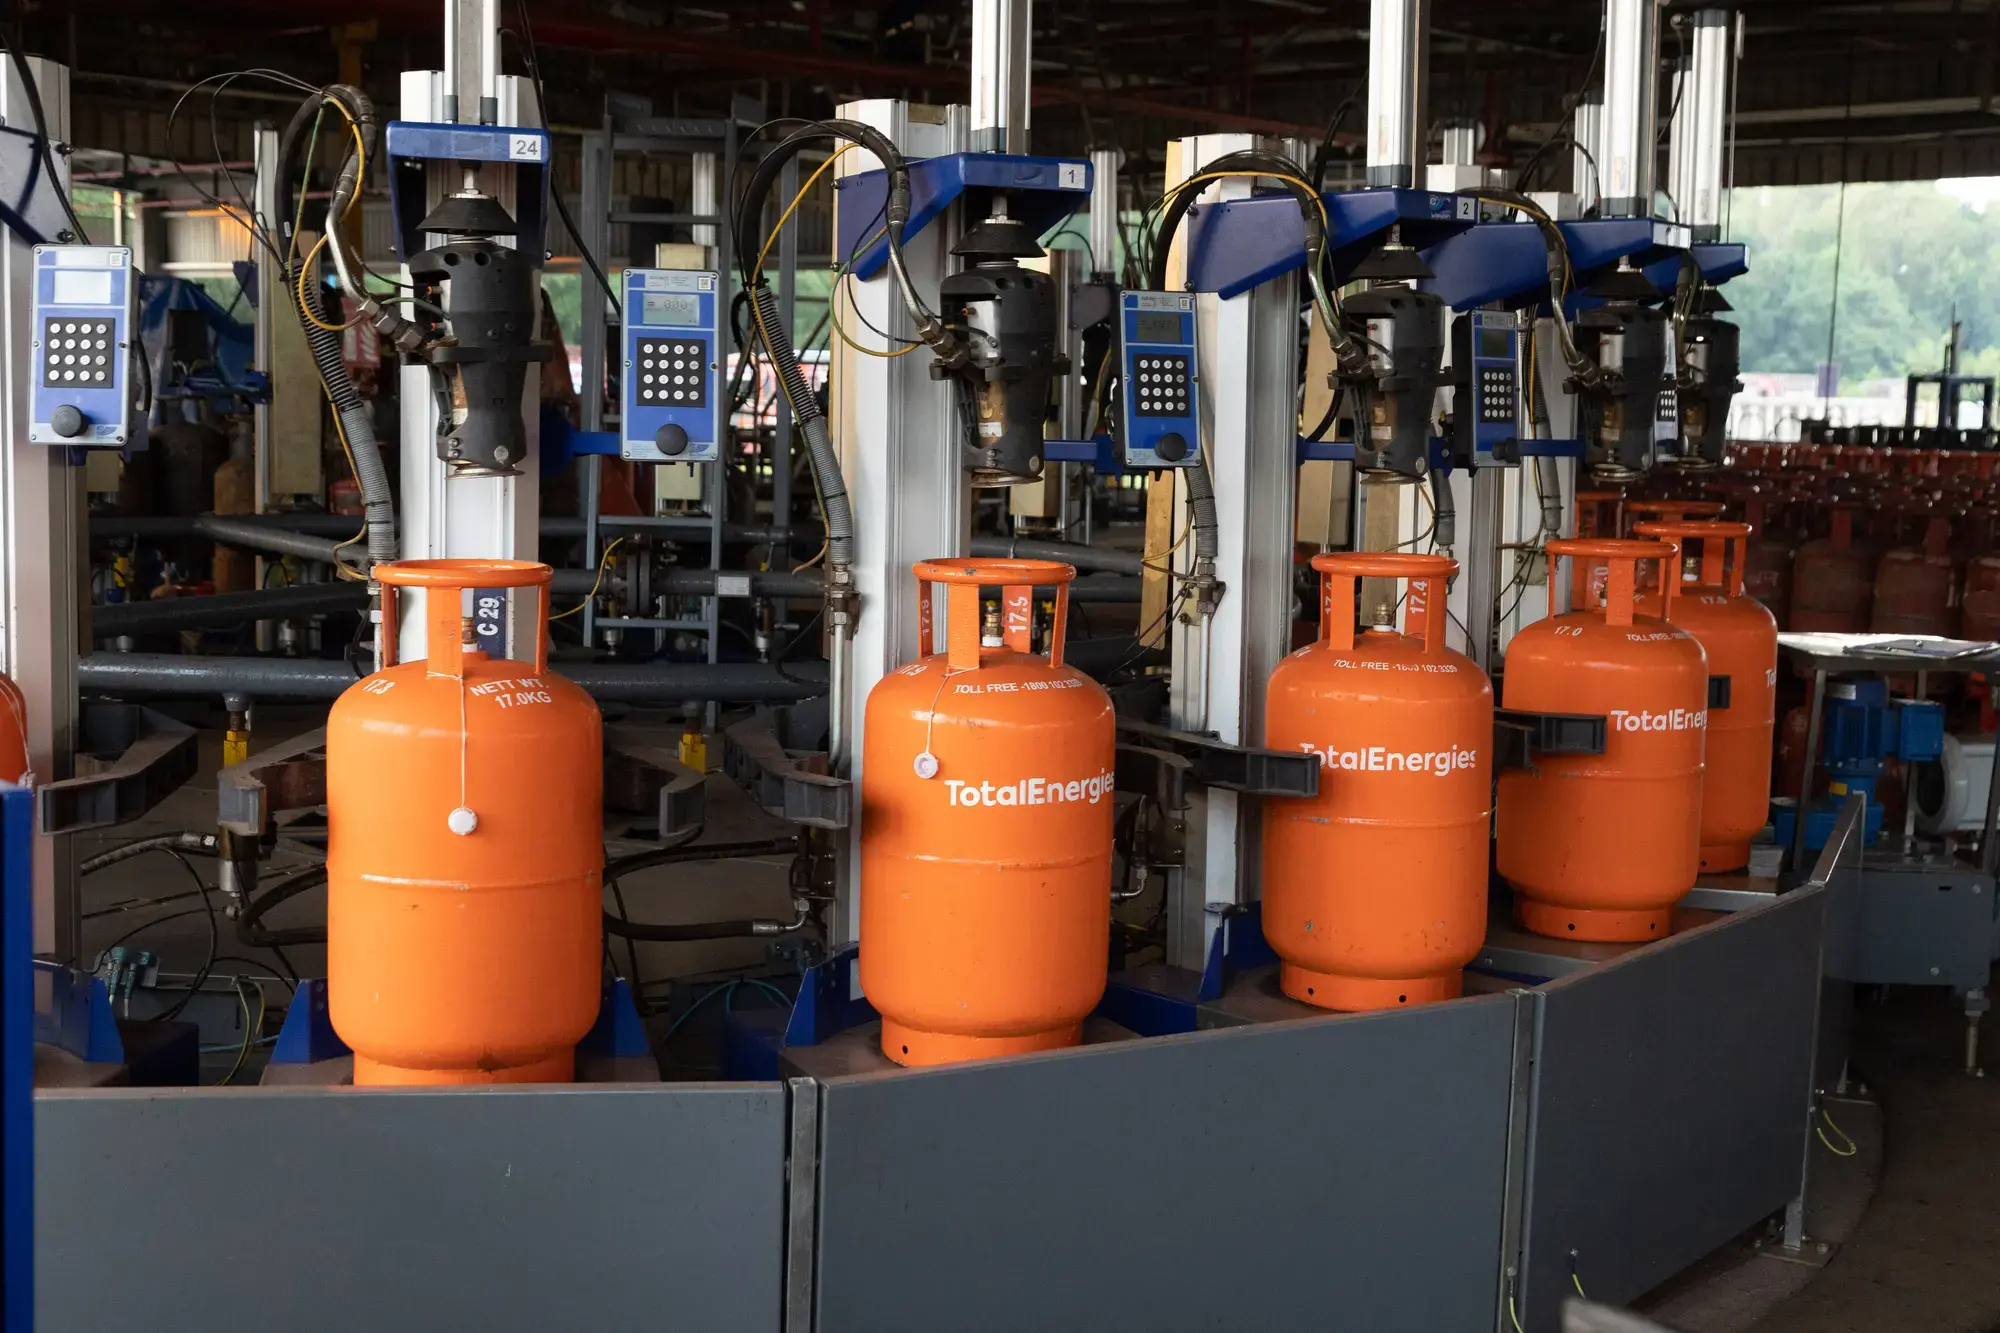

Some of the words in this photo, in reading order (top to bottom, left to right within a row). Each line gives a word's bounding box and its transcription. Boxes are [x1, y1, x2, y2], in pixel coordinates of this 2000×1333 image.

[516, 139, 538, 155] 24
[1068, 169, 1075, 184] 1
[1462, 202, 1470, 215] 2
[1410, 580, 1428, 615] 17.4
[478, 596, 500, 620] 29
[476, 622, 499, 636] C
[1554, 625, 1583, 637] 17.0
[1333, 659, 1358, 669] TOLL
[1361, 661, 1389, 671] FREE
[1421, 664, 1439, 673] 102
[362, 678, 396, 695] 17.3
[469, 679, 515, 697] NETT
[517, 678, 550, 690] WT.
[953, 683, 984, 695] TOLL
[987, 682, 1019, 693] FREE
[494, 691, 552, 709] 17.0KG
